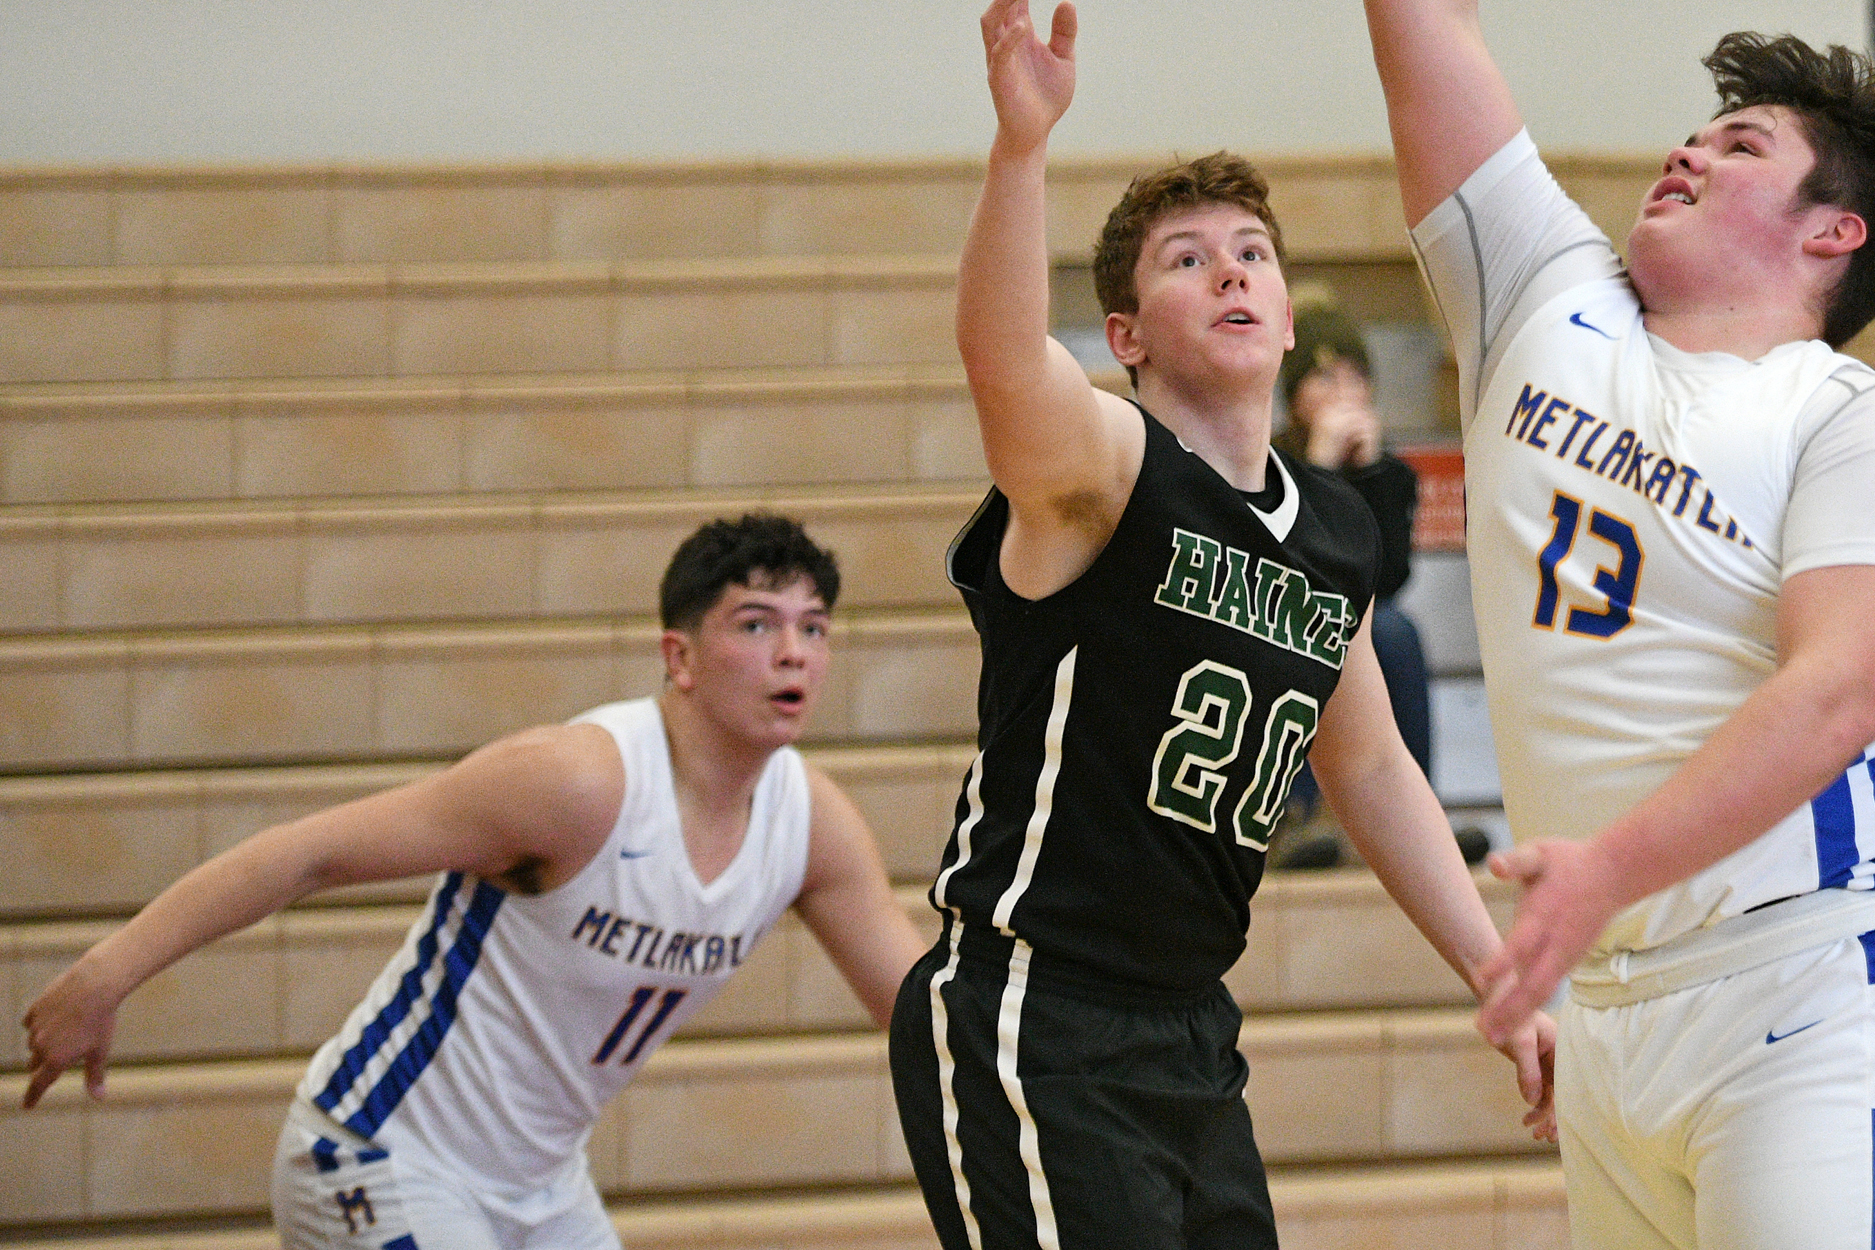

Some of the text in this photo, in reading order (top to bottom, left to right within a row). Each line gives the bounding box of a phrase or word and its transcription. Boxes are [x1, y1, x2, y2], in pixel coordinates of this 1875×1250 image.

[1531, 488, 1645, 642] 13
[1147, 658, 1319, 853] 20
[590, 985, 690, 1067] 11
[335, 1186, 377, 1235] M
